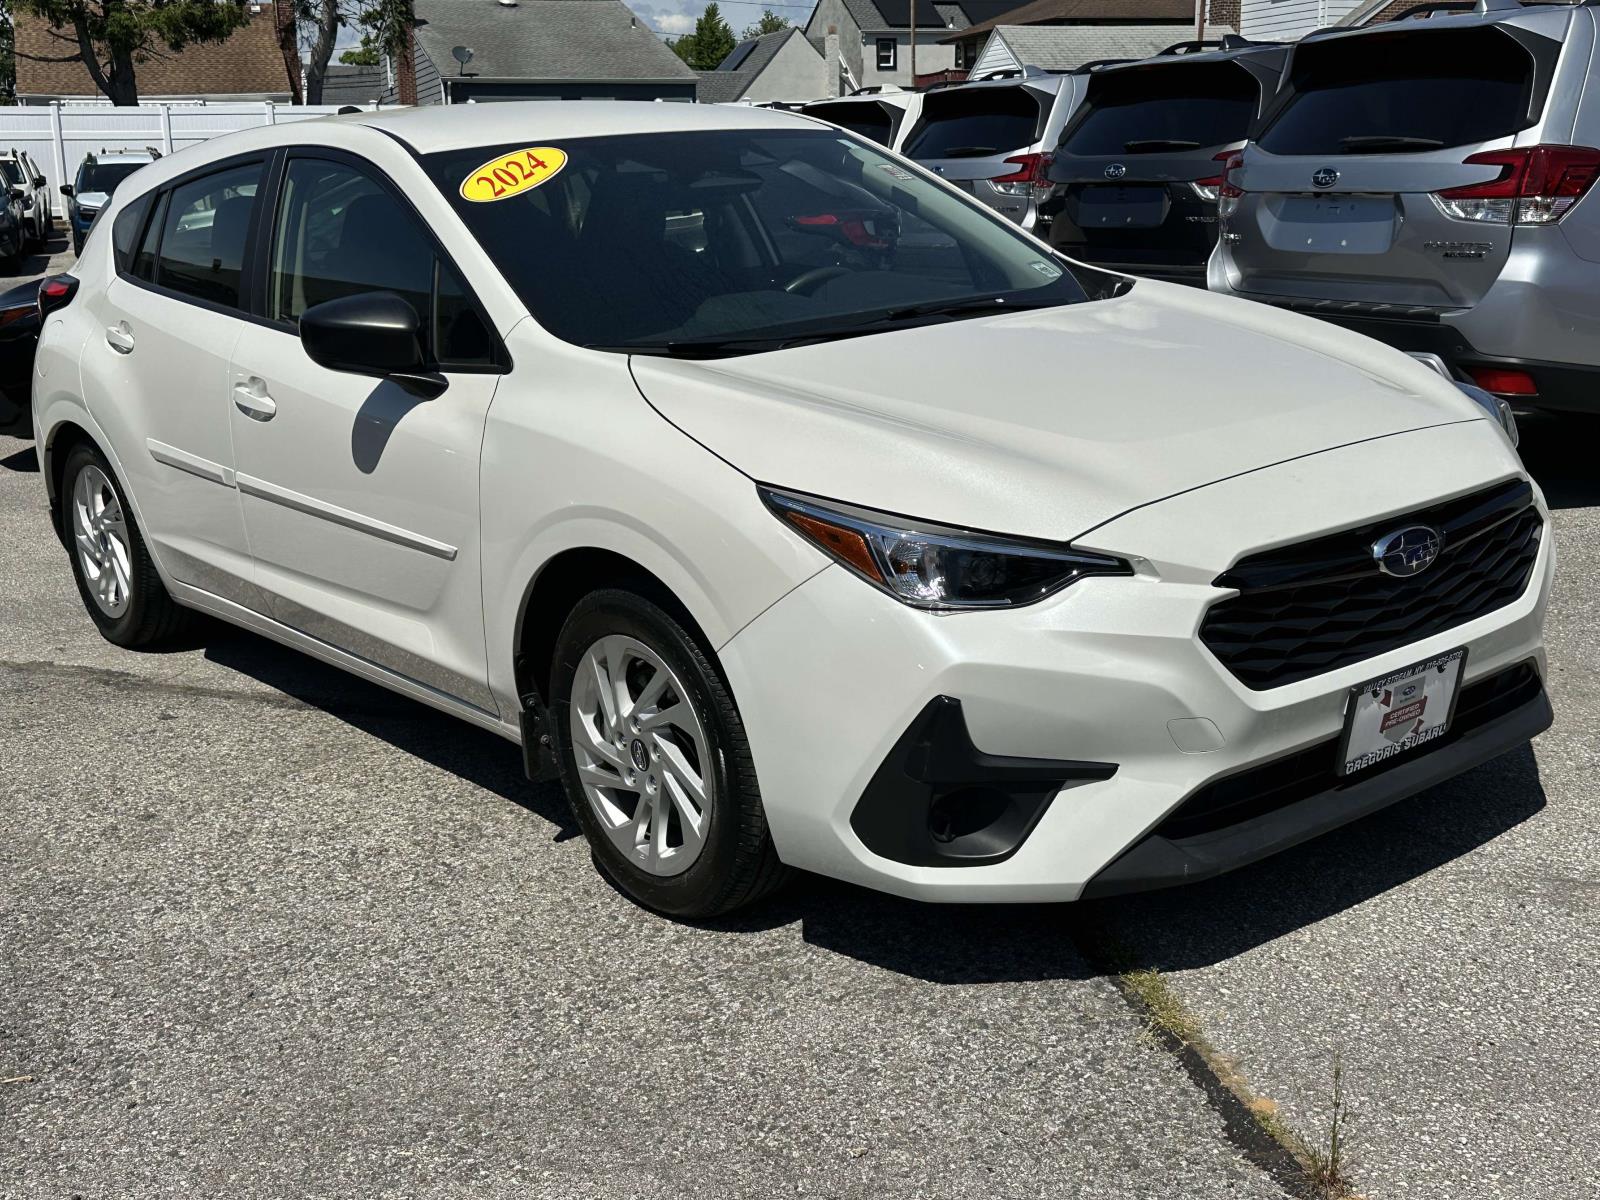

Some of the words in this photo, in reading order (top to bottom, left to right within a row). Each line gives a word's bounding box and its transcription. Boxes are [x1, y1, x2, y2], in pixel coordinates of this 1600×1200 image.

[477, 152, 548, 197] 2024
[1364, 678, 1386, 694] VALLEY
[1390, 704, 1420, 718] CERTIFIED
[1346, 743, 1401, 775] GREGORIS
[1404, 724, 1446, 750] SUBARU
